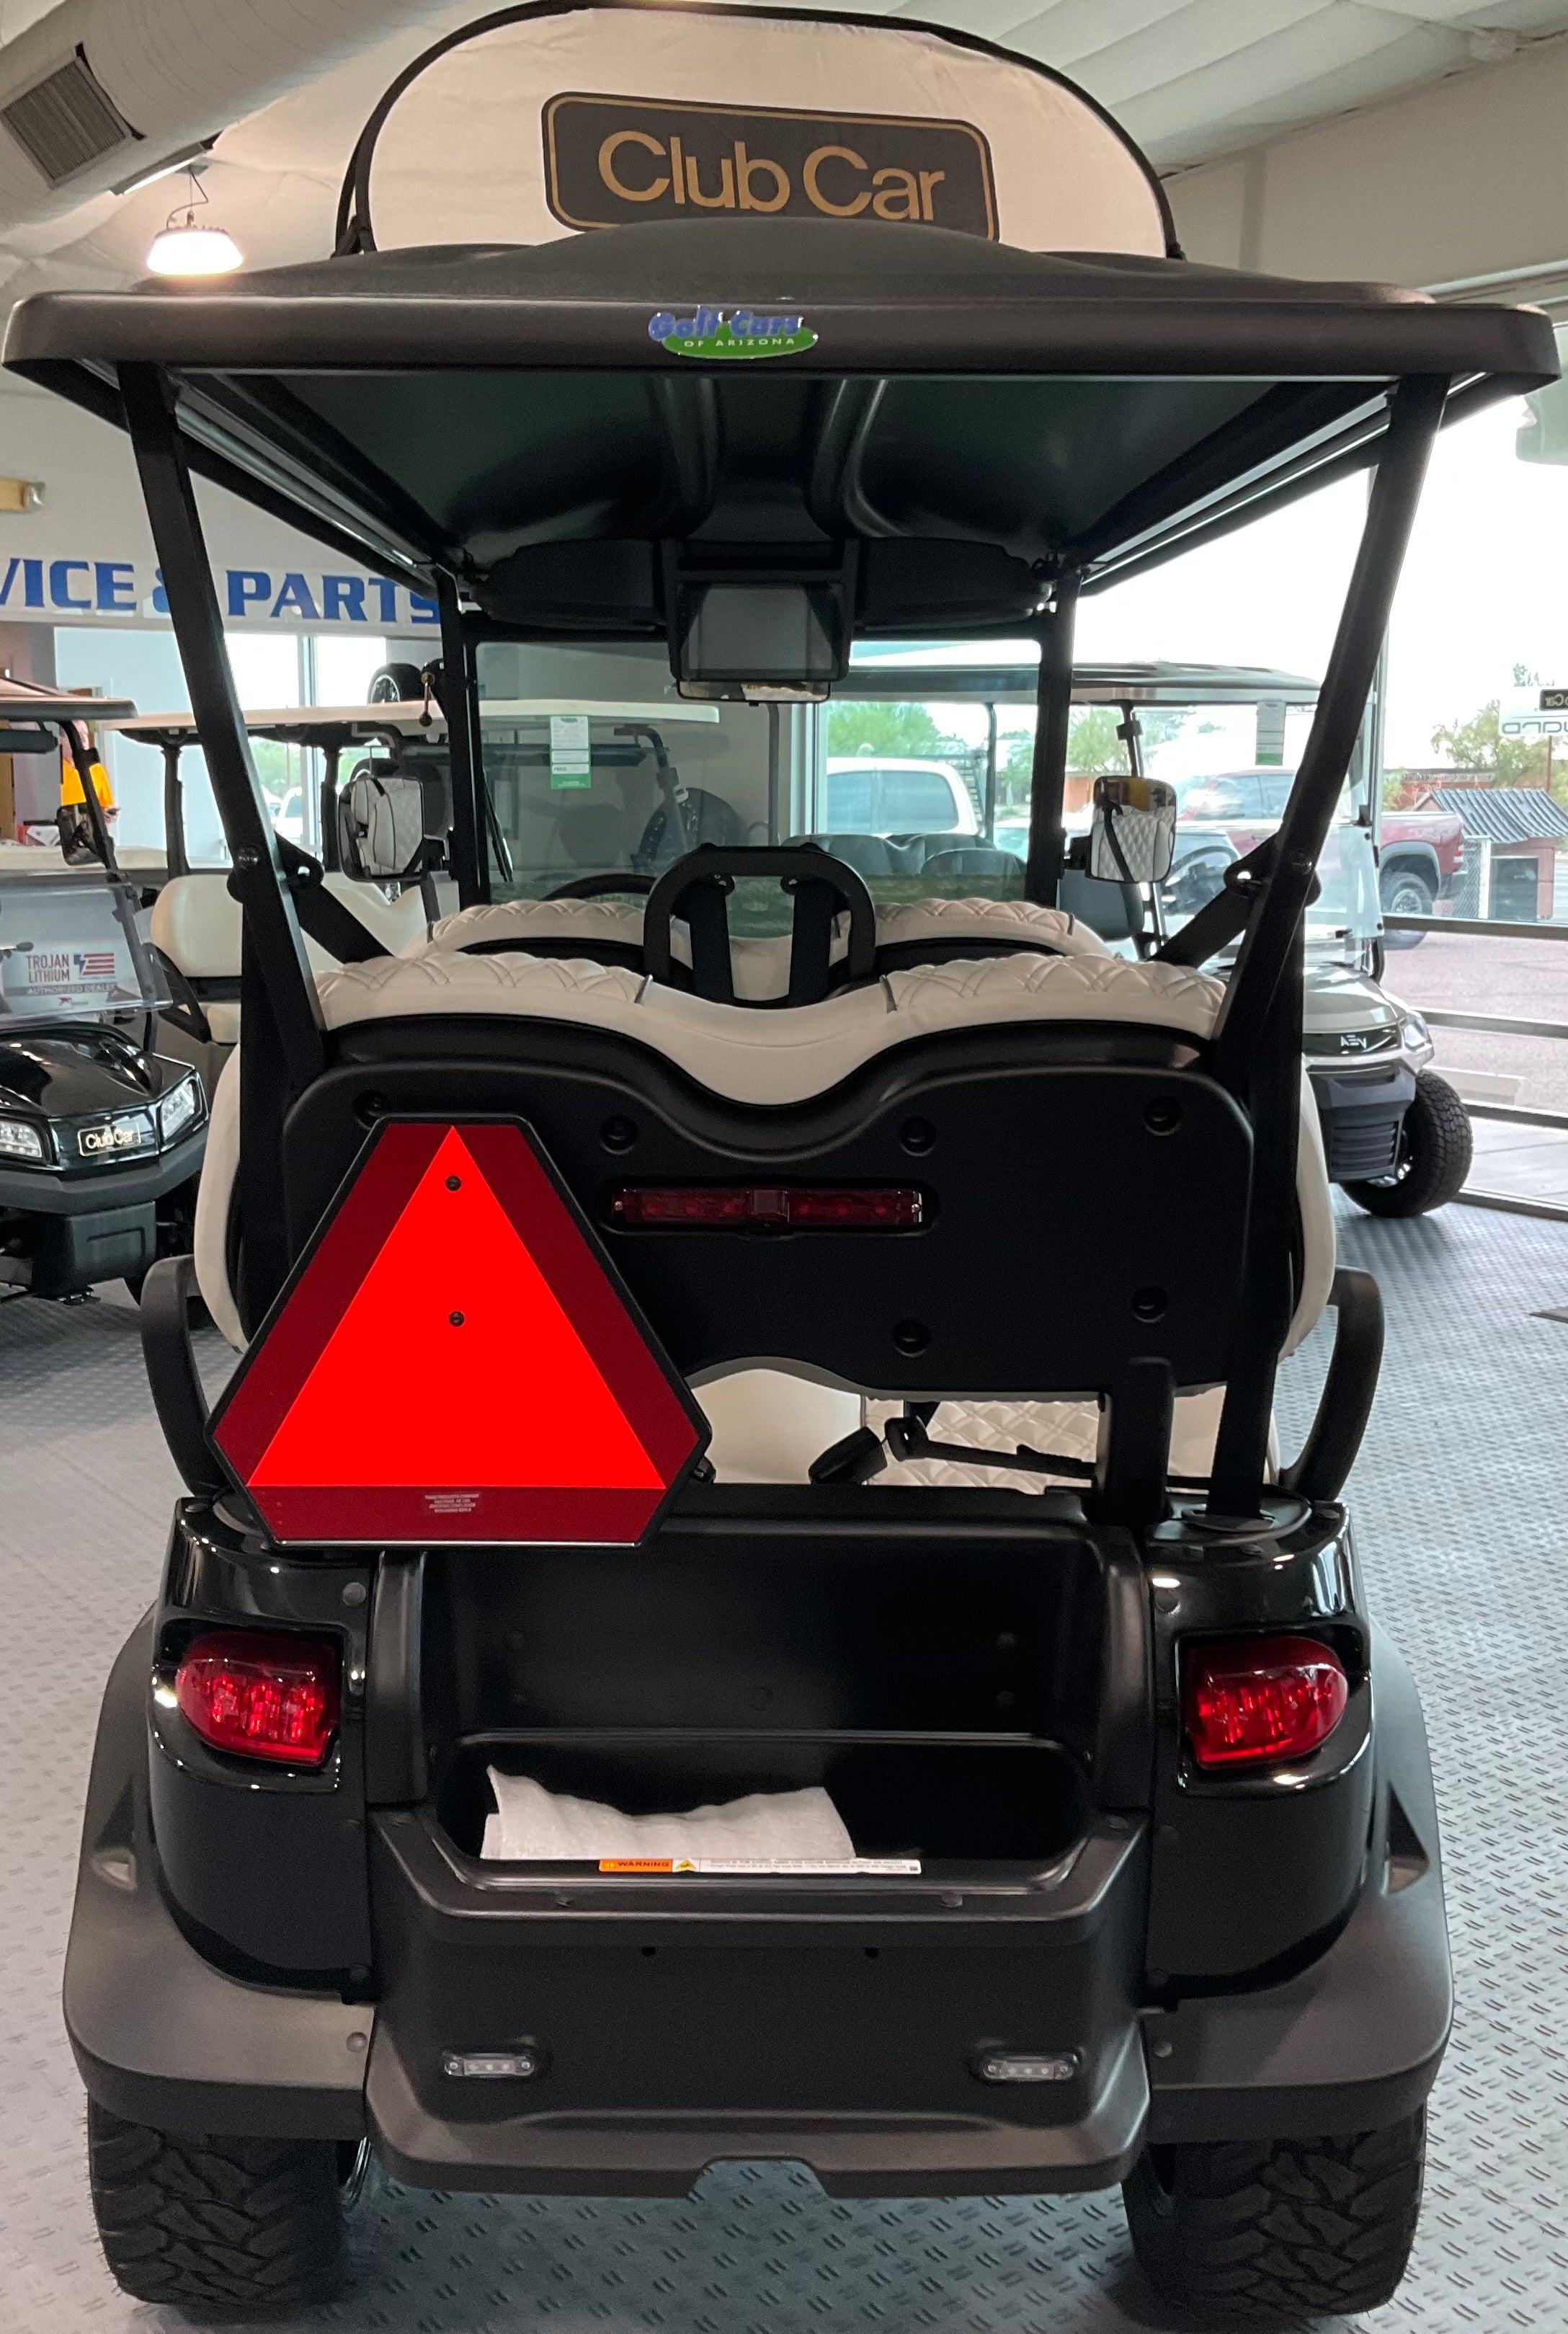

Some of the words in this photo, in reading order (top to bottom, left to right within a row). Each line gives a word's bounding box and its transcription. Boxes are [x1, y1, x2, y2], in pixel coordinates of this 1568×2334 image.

[598, 130, 790, 212] Club
[803, 146, 945, 220] Car
[649, 306, 723, 342] Golf
[728, 310, 804, 338] Cars
[715, 338, 796, 347] ARIZONA
[26, 954, 70, 969] TROJAN
[28, 969, 71, 984] LITHIUM
[27, 984, 84, 995] AUTHORIZED
[114, 1128, 134, 1145] Car
